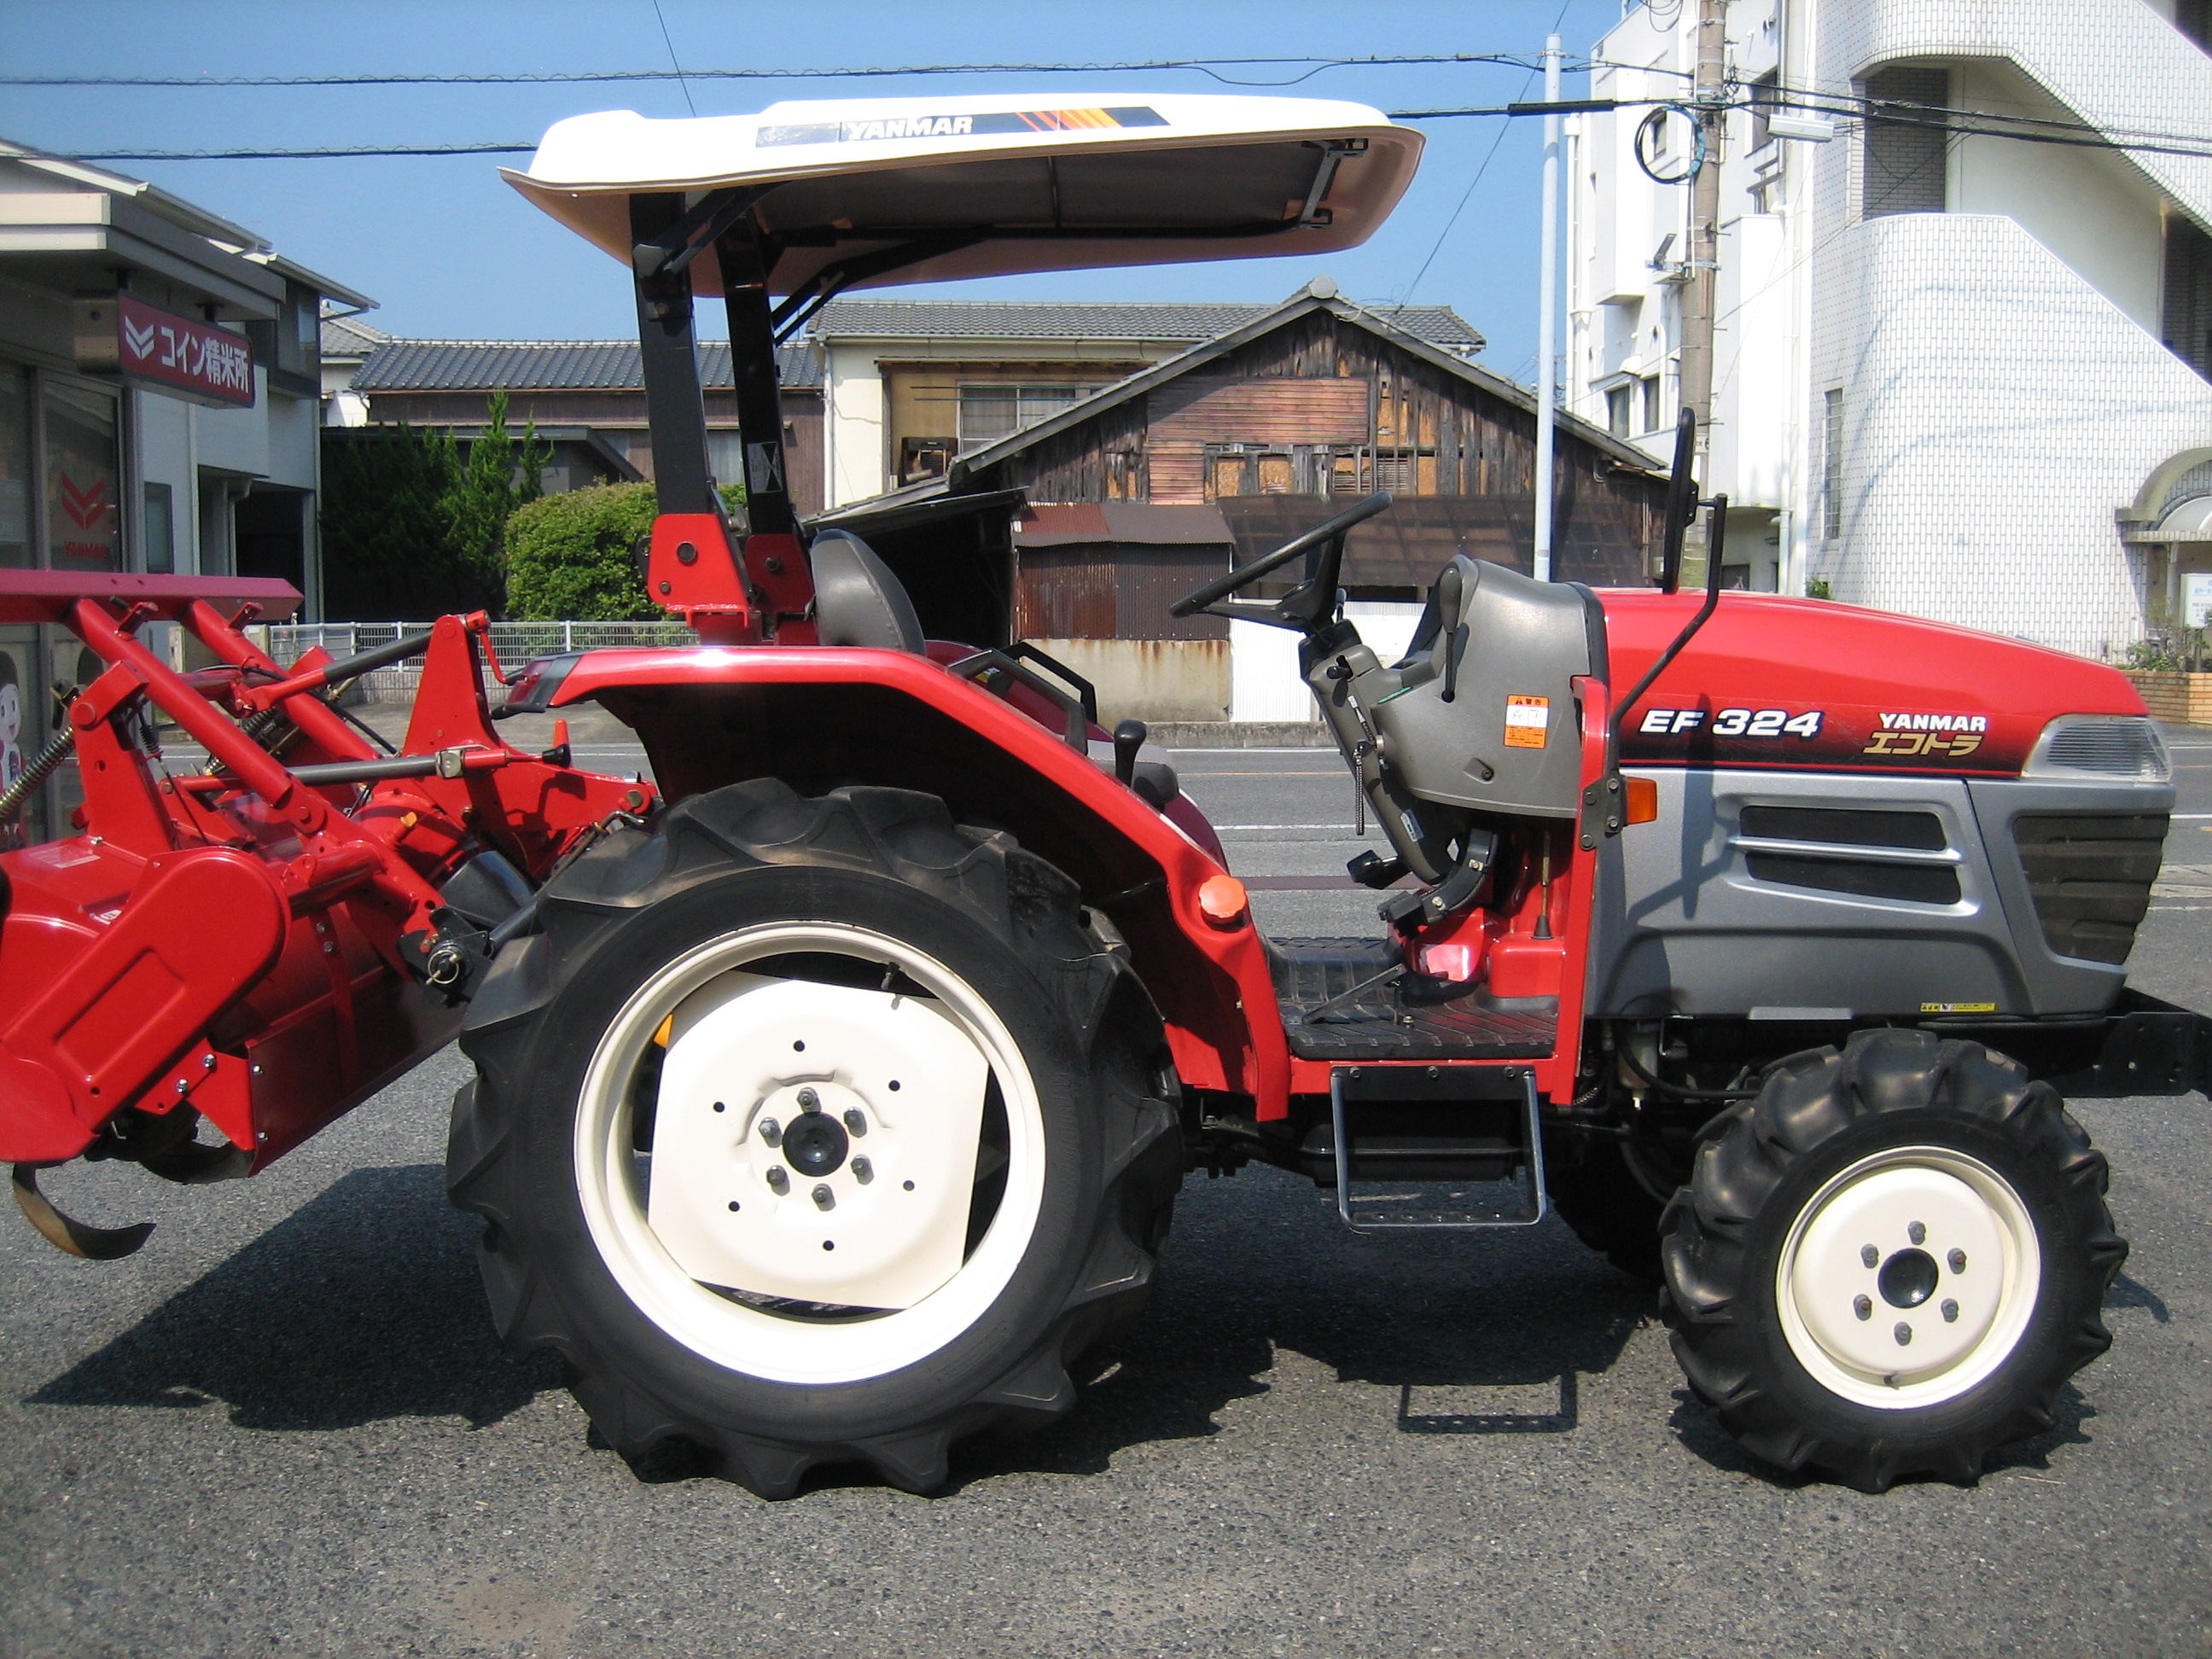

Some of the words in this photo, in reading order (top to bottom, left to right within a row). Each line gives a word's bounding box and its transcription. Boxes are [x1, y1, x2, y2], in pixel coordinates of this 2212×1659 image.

[848, 116, 973, 141] YANMAR
[1639, 710, 1704, 733] EF
[1712, 708, 1821, 736] 324
[1879, 713, 1987, 732] YANMAR
[1863, 731, 1983, 756] エコトラ
